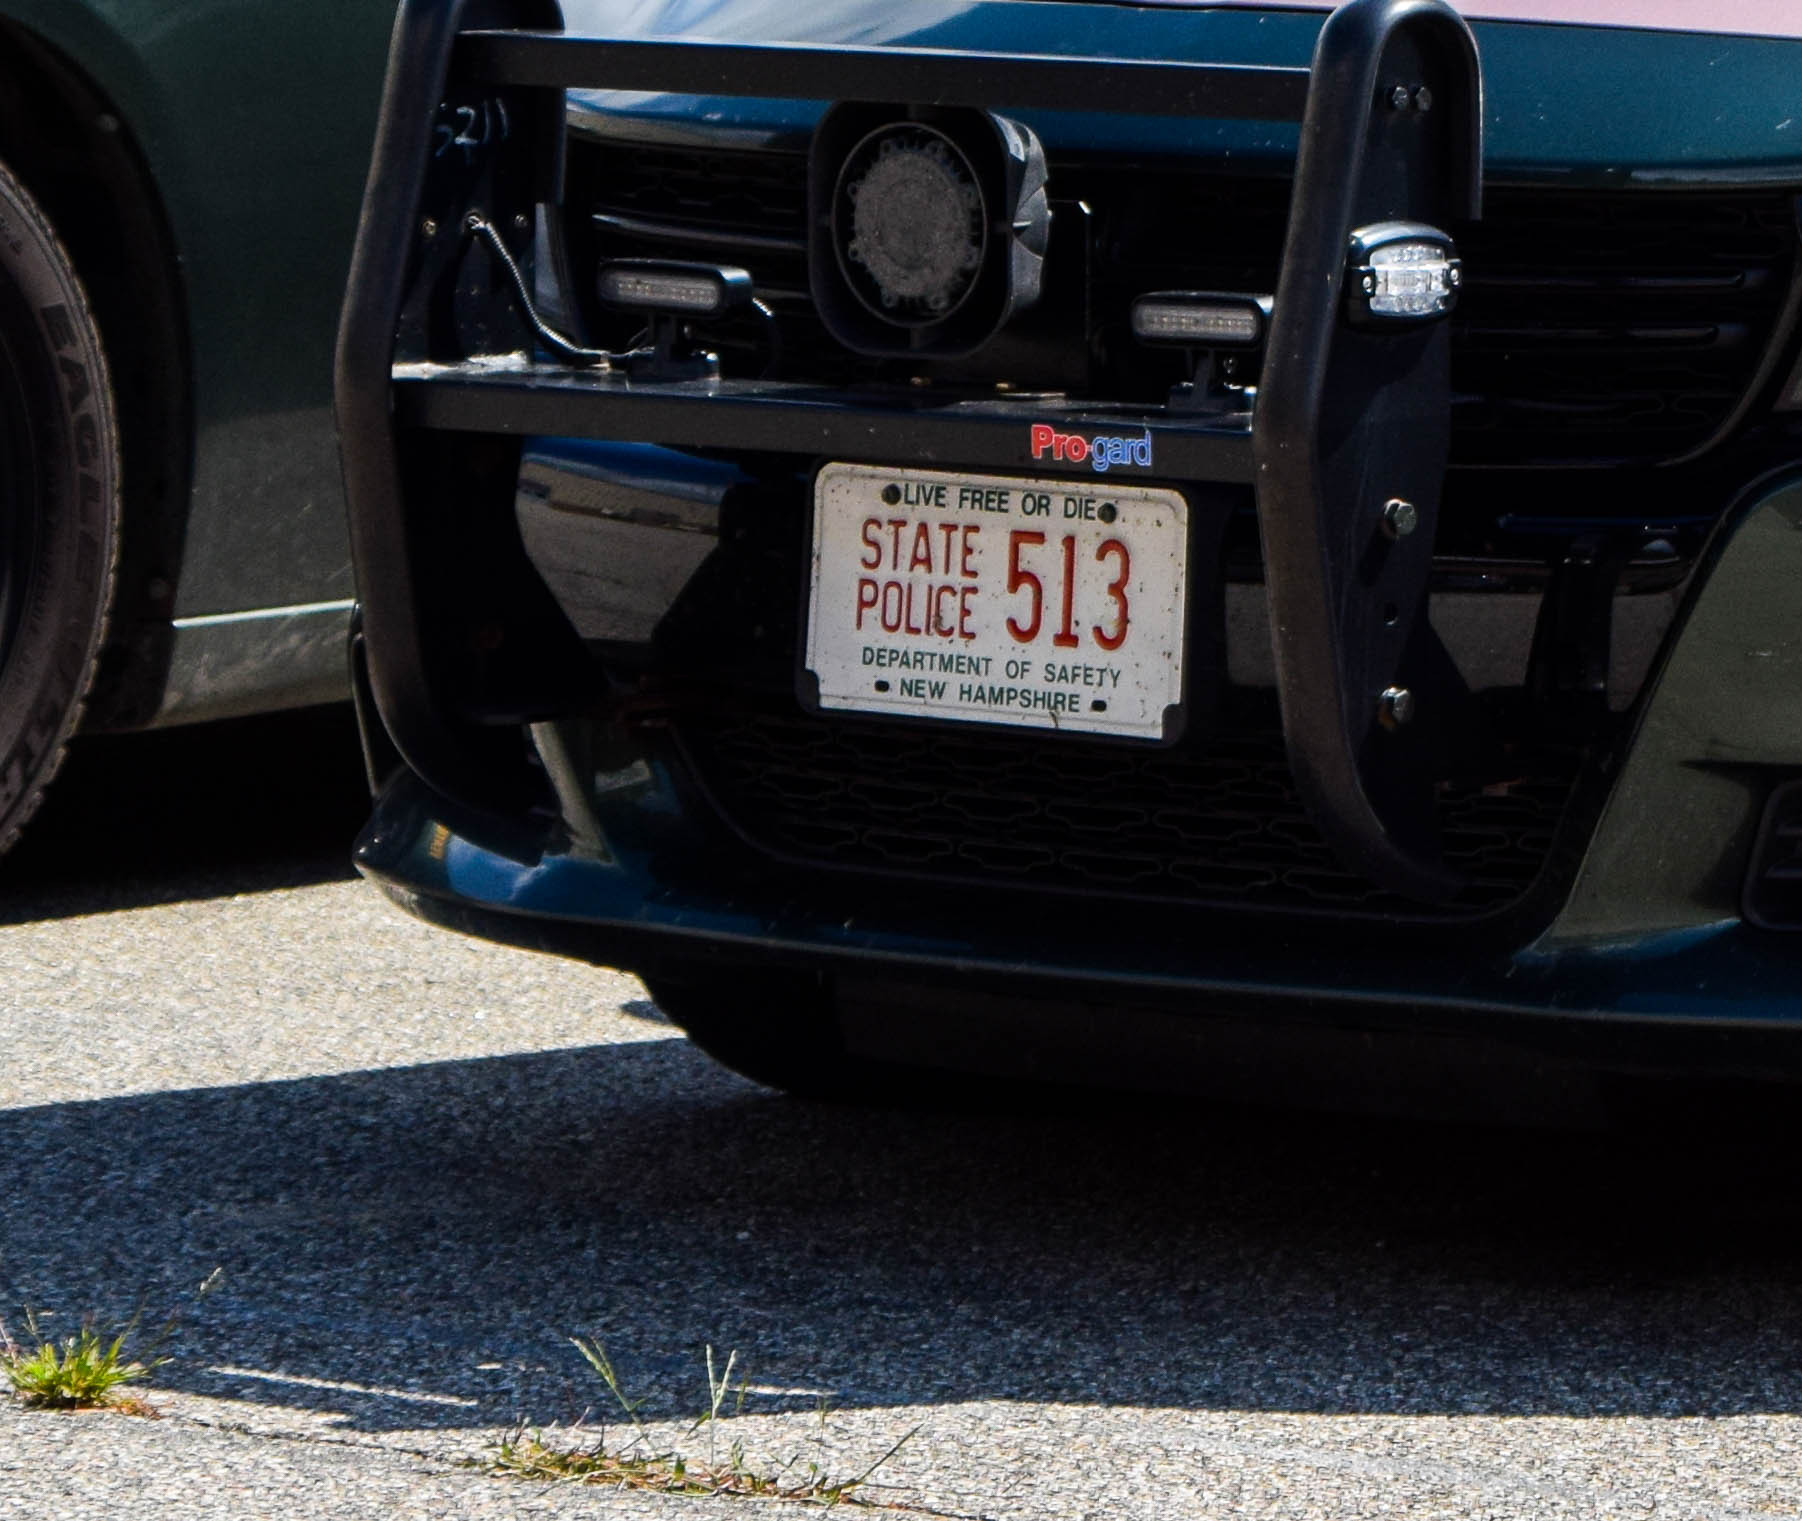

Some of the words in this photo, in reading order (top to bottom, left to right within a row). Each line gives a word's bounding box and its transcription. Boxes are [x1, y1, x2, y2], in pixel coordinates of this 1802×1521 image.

[903, 483, 947, 508] LIVE
[958, 488, 1010, 514] FREE
[1021, 494, 1051, 517] OR
[1064, 498, 1097, 521] DIE
[860, 518, 981, 579] STATE
[856, 578, 980, 640] POLICE
[1005, 529, 1131, 651] 513
[861, 646, 993, 678] DEPARTMENT
[1005, 660, 1031, 681] OF
[1043, 663, 1122, 690] SAFETY
[899, 679, 946, 700] NEW
[959, 684, 1081, 713] HAMPSHIRE
